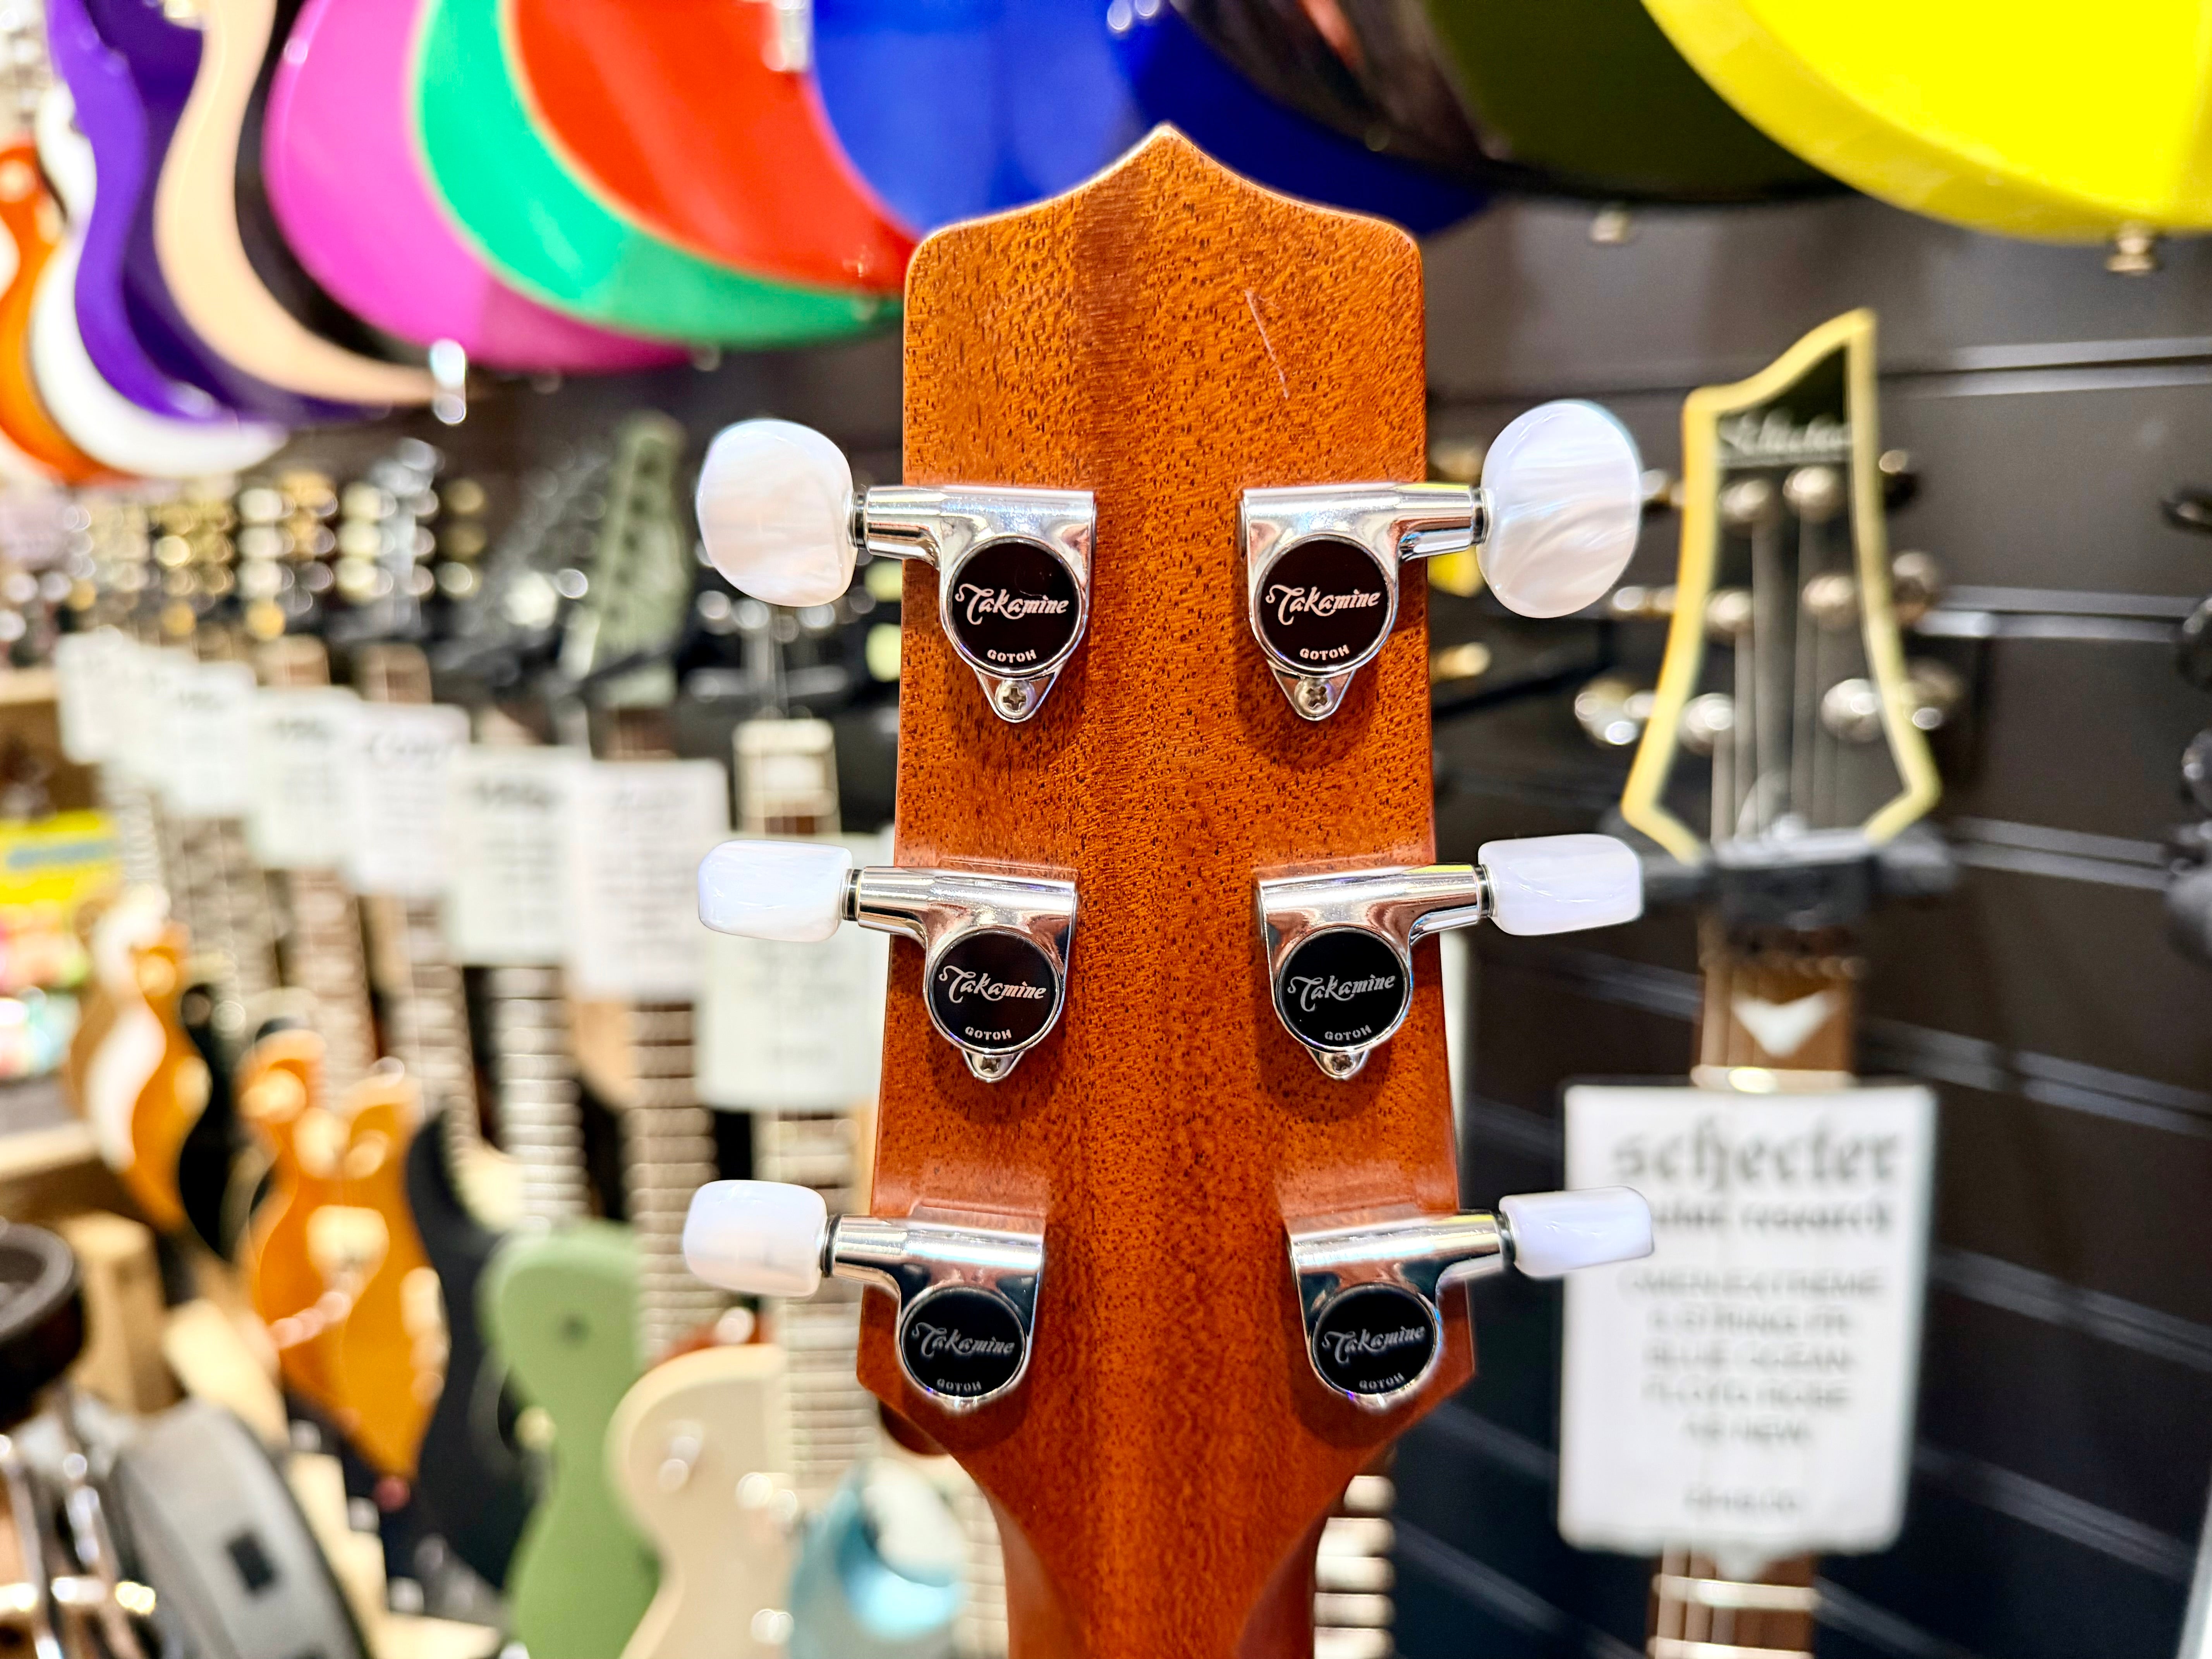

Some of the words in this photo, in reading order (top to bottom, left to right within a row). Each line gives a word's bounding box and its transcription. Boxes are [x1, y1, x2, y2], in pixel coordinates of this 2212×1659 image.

[955, 583, 1069, 625] Takamine
[1265, 584, 1382, 625] Takamine
[987, 649, 1037, 663] GOTOH
[1299, 644, 1350, 661] GOTOH
[935, 965, 1047, 1003] Takamine
[1287, 974, 1396, 1012] Takamine
[965, 1026, 1012, 1044] GOTOH
[1324, 1024, 1372, 1041] GOTOH
[911, 1322, 1015, 1358] Takamine
[1321, 1326, 1426, 1364] Takamine
[936, 1378, 982, 1393] GOTOH
[1358, 1372, 1406, 1390] GOTOH
